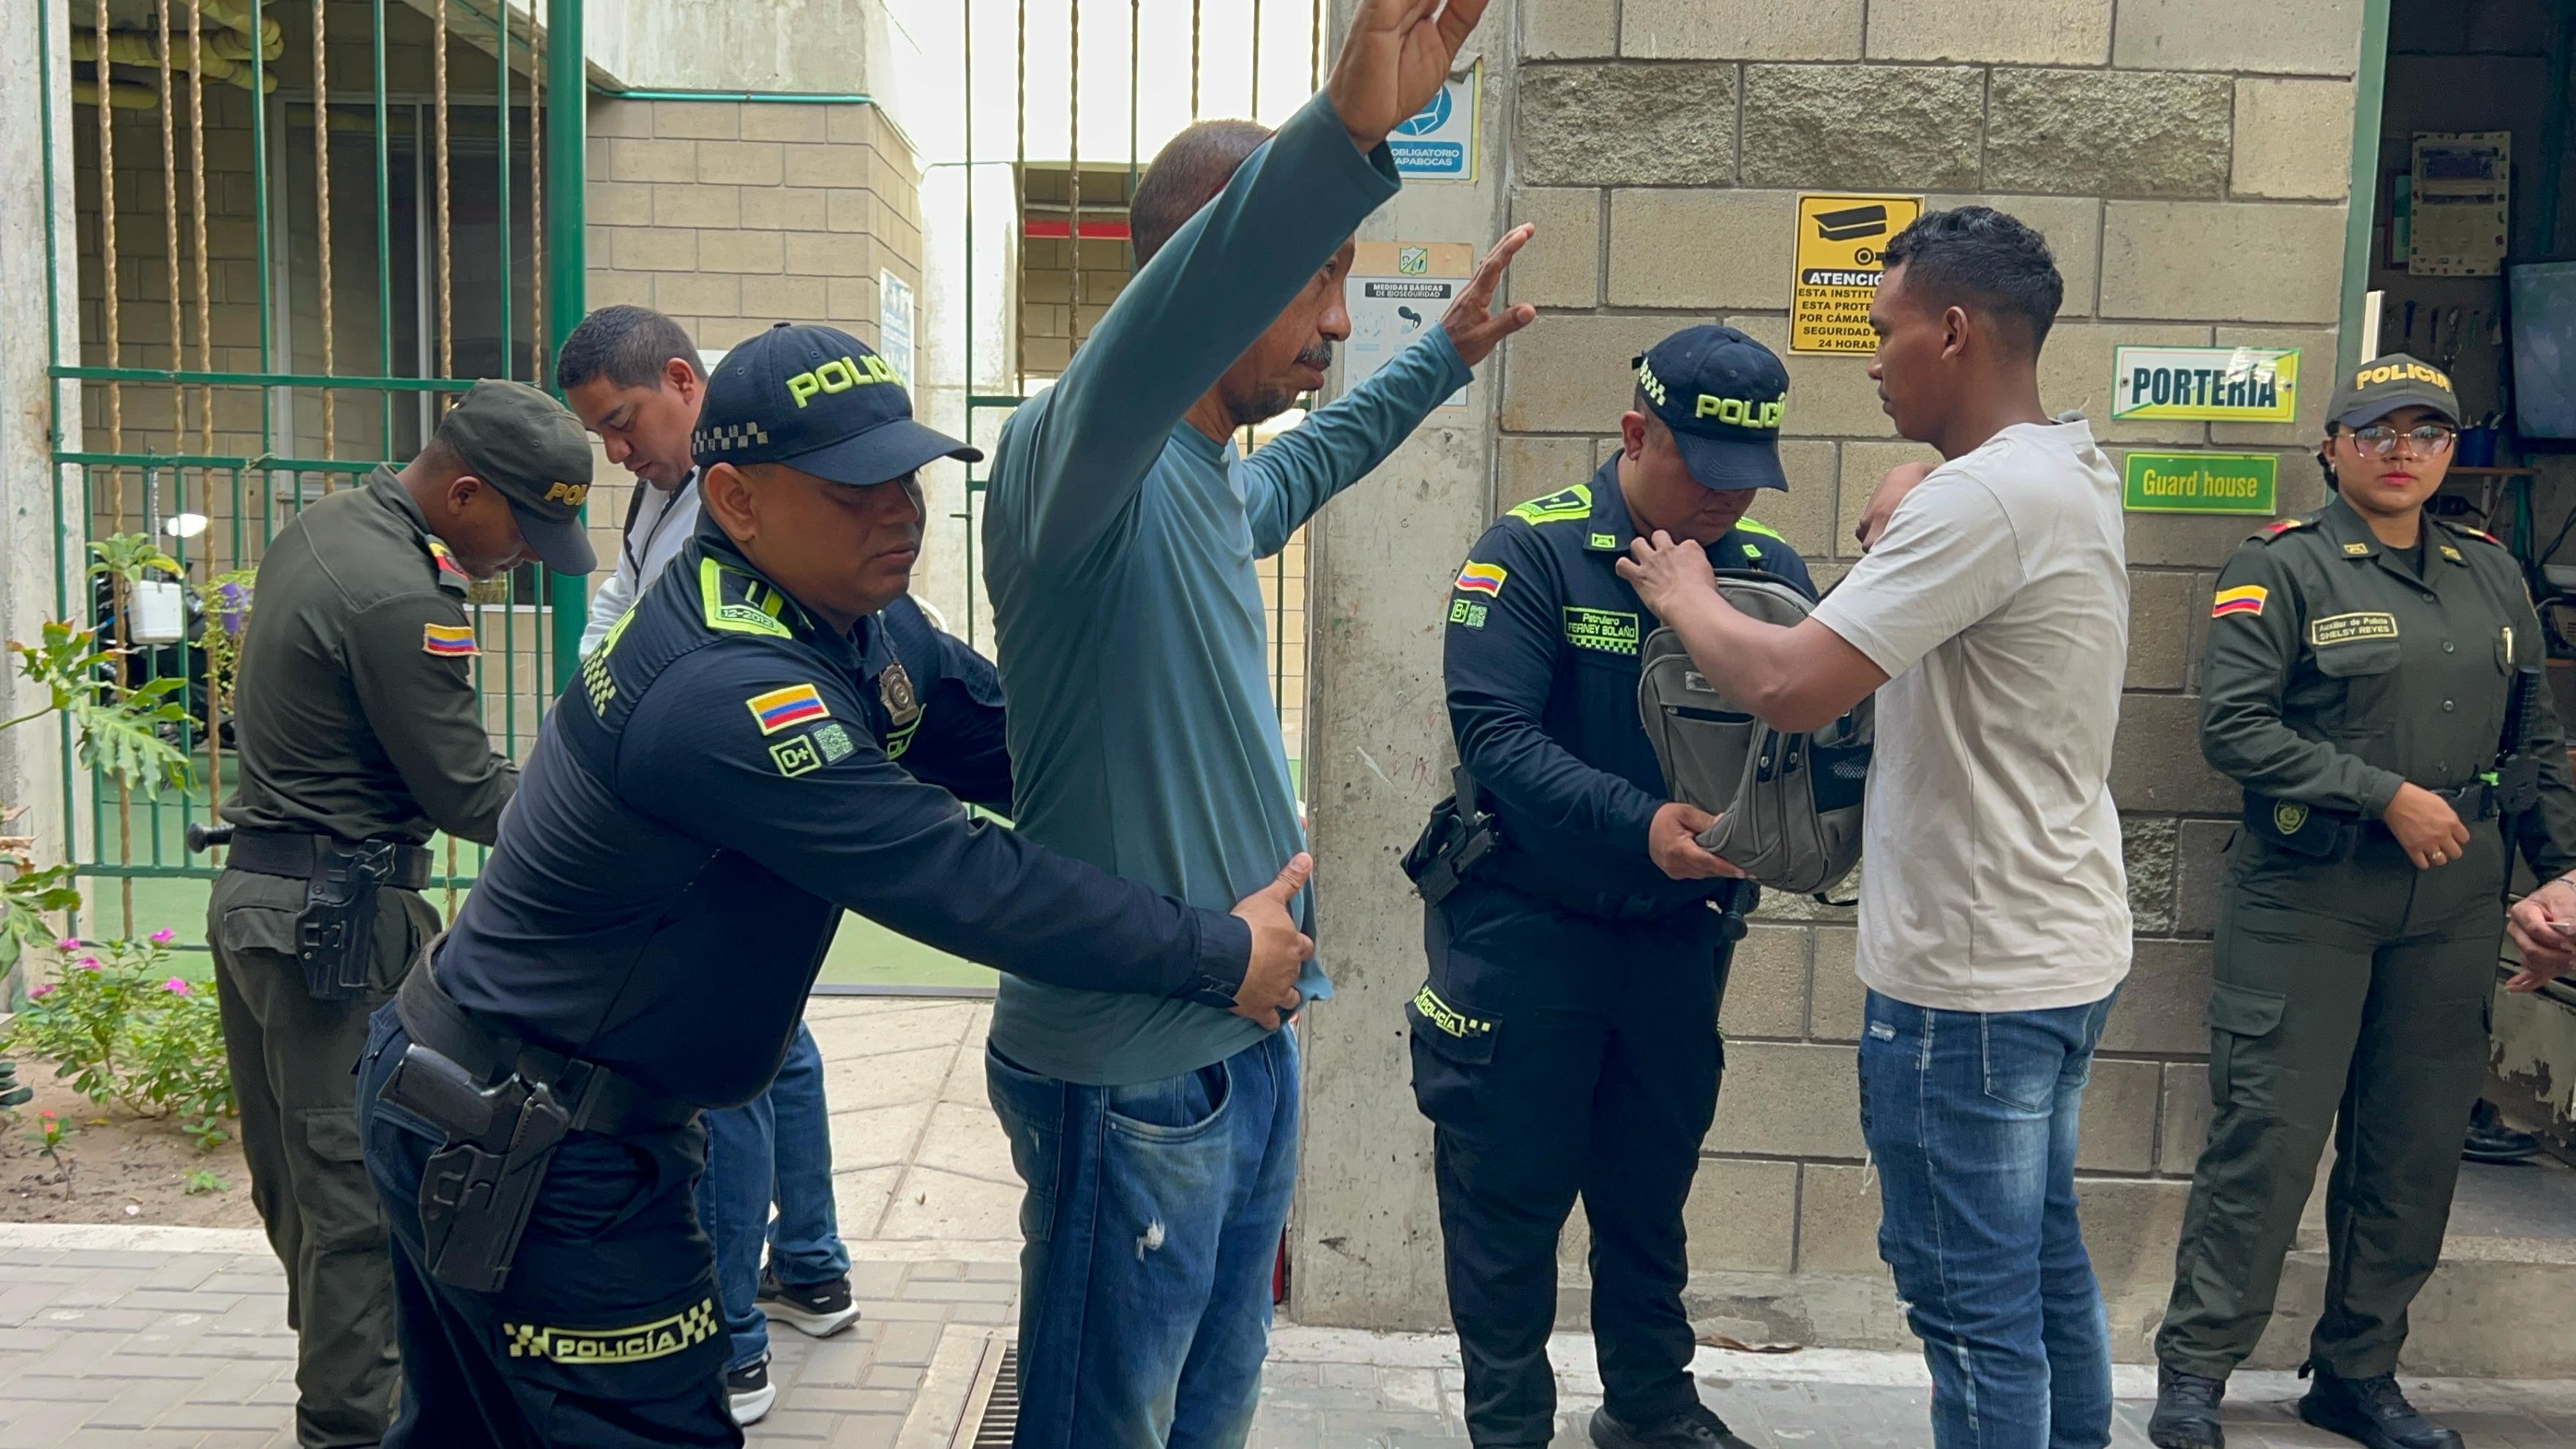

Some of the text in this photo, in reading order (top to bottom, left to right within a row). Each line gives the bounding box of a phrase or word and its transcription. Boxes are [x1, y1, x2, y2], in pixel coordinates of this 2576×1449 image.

[1391, 148, 1459, 157] OBLIGATORIO
[1393, 157, 1453, 166] APABOCAS
[1809, 272, 1884, 285] ATENCIÓ
[1798, 288, 1827, 297] ESTA
[1802, 302, 1872, 311] ESTA PROTE
[1800, 313, 1868, 323] POR CÁMAR
[1803, 326, 1871, 337] SEGURIDAD
[1818, 340, 1876, 349] 24 HORAS
[2132, 364, 2277, 408] PORTERÍA
[1696, 392, 1785, 428] POLICÍ
[2143, 469, 2258, 498] Guard house
[723, 609, 772, 626] 12-2012
[1568, 622, 1600, 634] FERNEY
[2320, 626, 2389, 640] SHELSY REYES
[1422, 997, 1456, 1031] POLICÍA
[556, 1331, 678, 1357] POLICÍA
